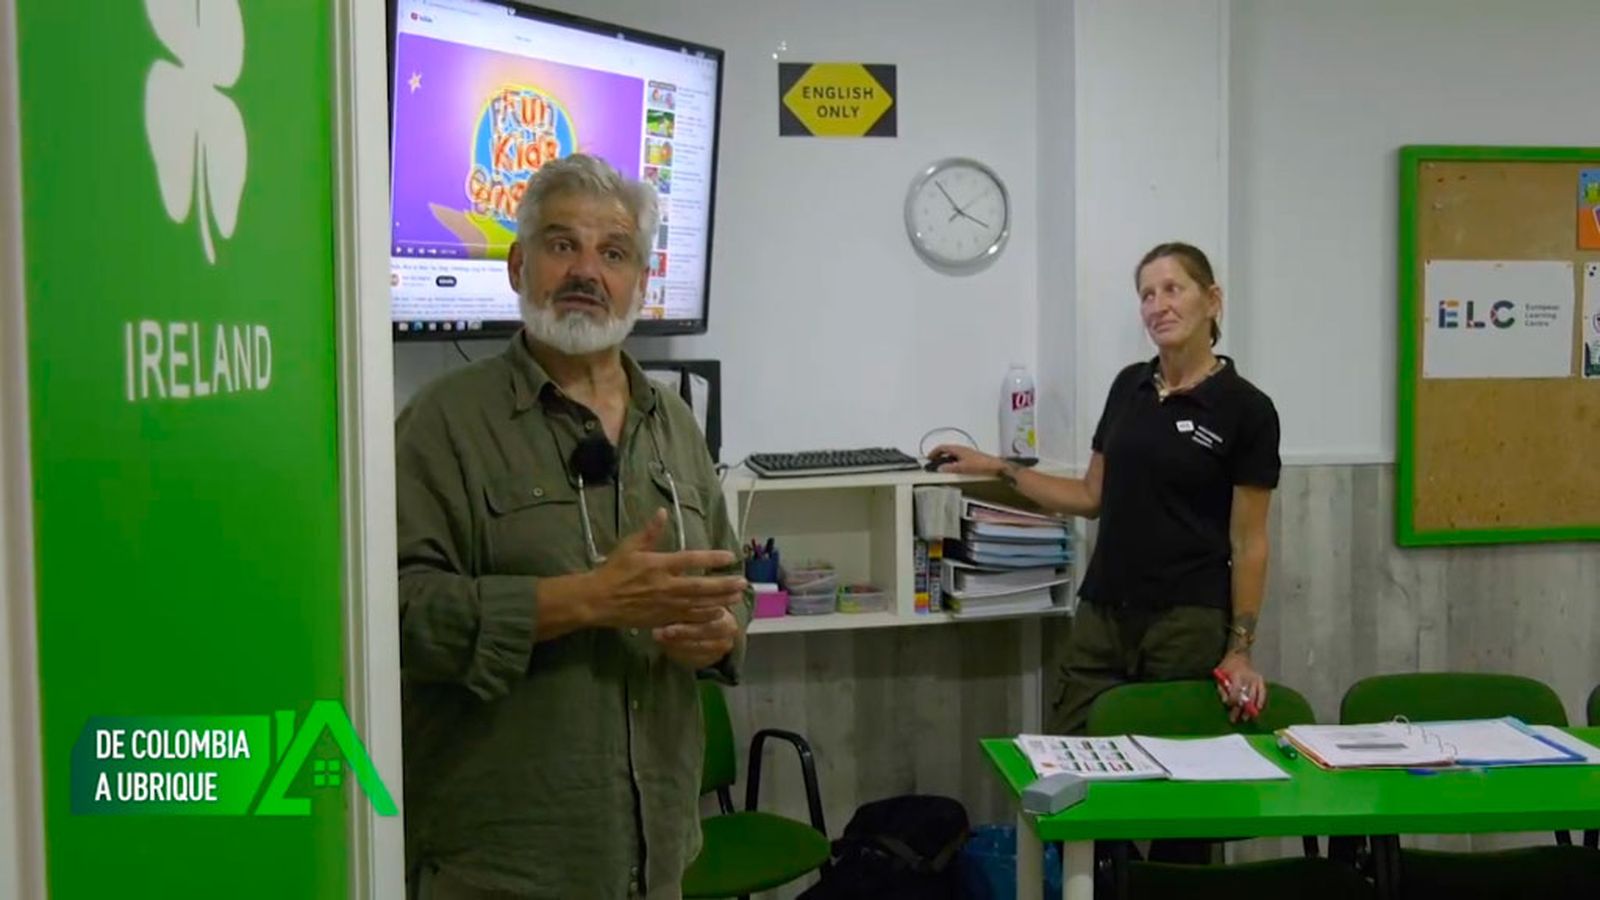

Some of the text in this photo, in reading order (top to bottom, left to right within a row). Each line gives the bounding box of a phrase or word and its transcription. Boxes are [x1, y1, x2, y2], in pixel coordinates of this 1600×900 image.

[802, 86, 874, 99] ENGLISH
[816, 105, 860, 118] ONLY
[1438, 300, 1516, 328] ELC
[125, 320, 273, 402] IRELAND
